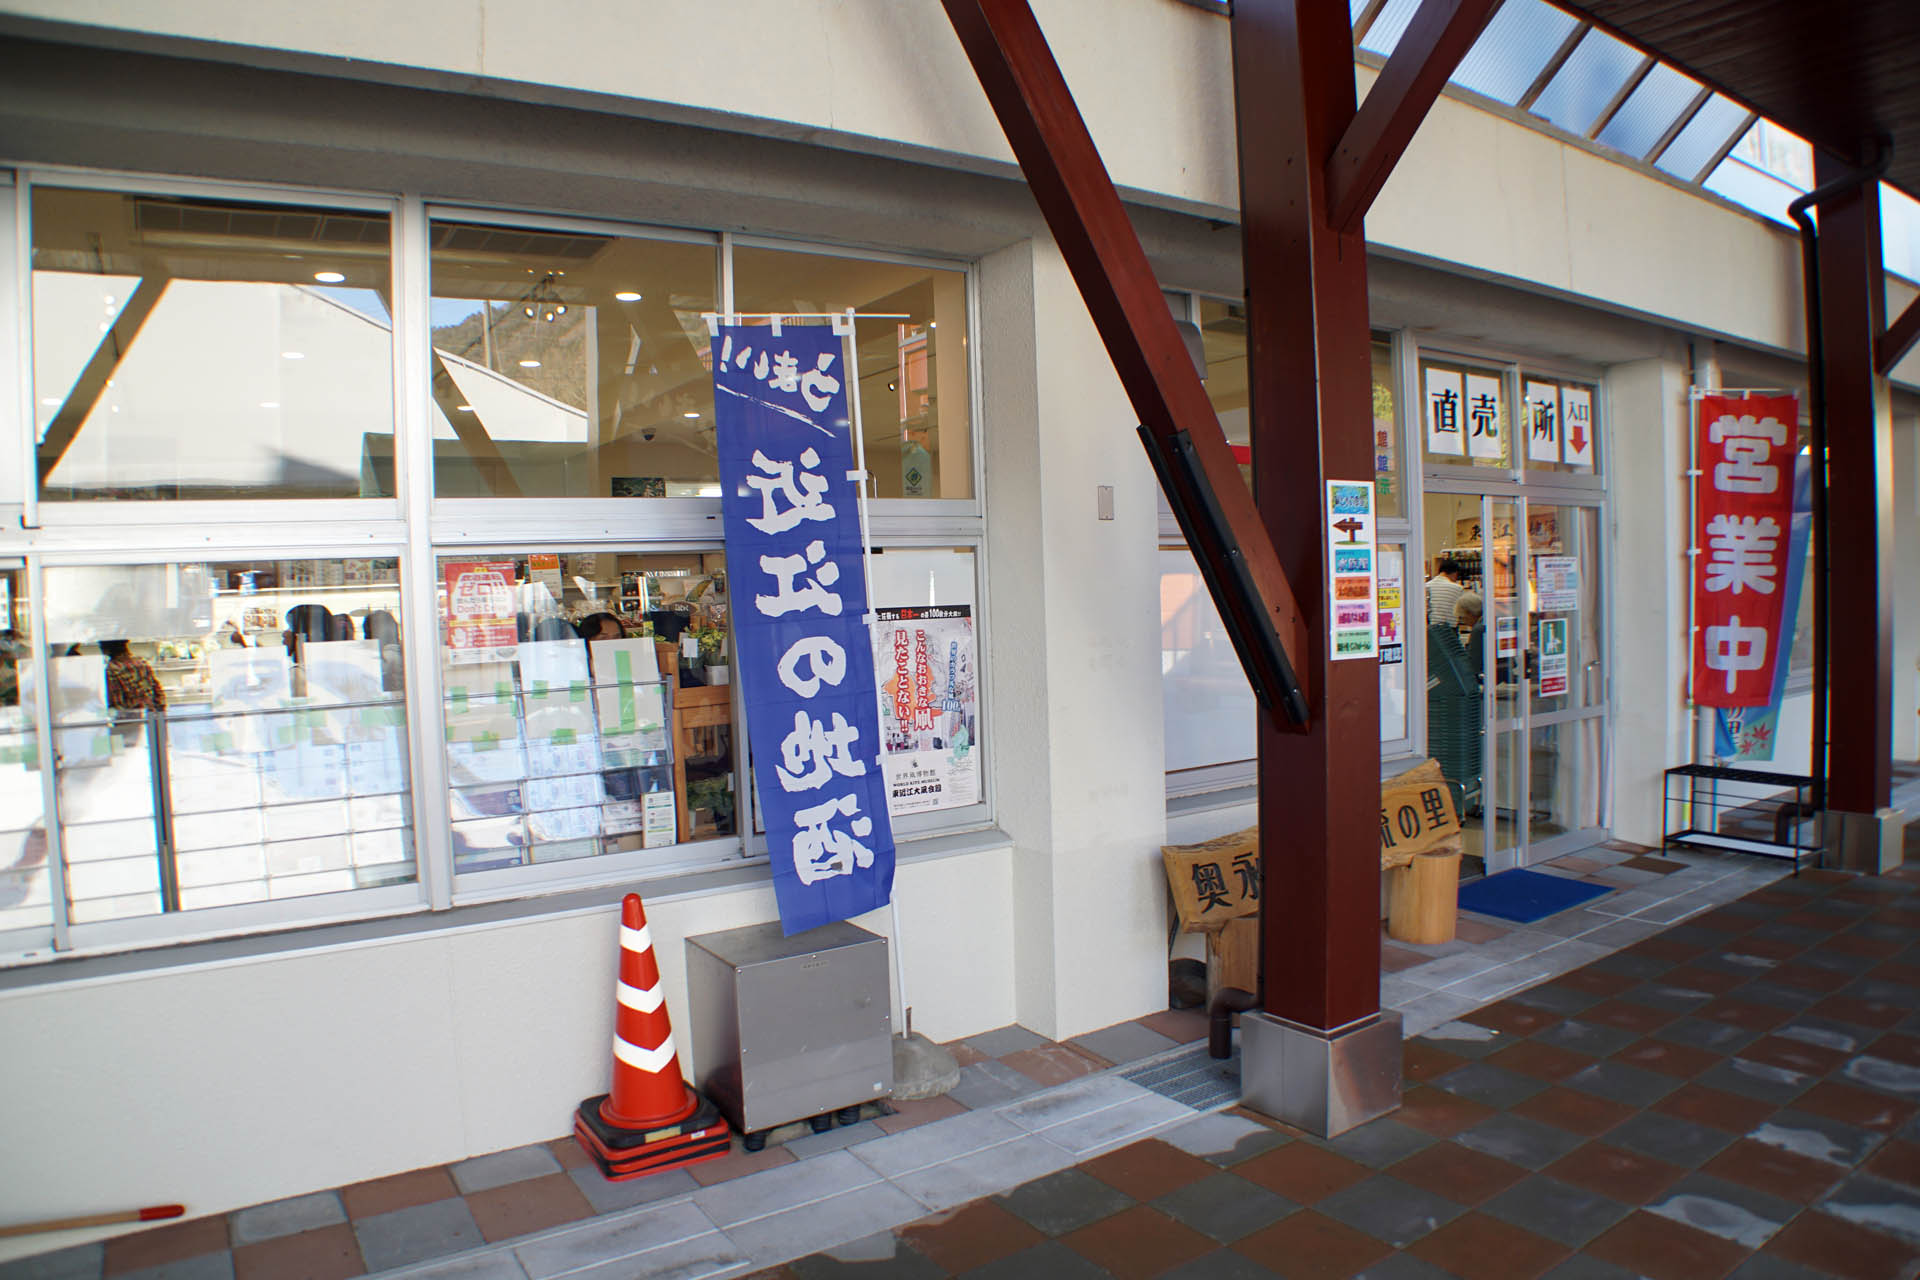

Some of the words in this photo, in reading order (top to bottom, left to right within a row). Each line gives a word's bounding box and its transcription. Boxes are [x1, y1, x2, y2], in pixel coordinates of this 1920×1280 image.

[1431, 388, 1555, 443] 直売所
[1567, 401, 1589, 422] 入口
[1704, 414, 1788, 694] 営業中
[914, 628, 935, 731] こんなおおきな凧
